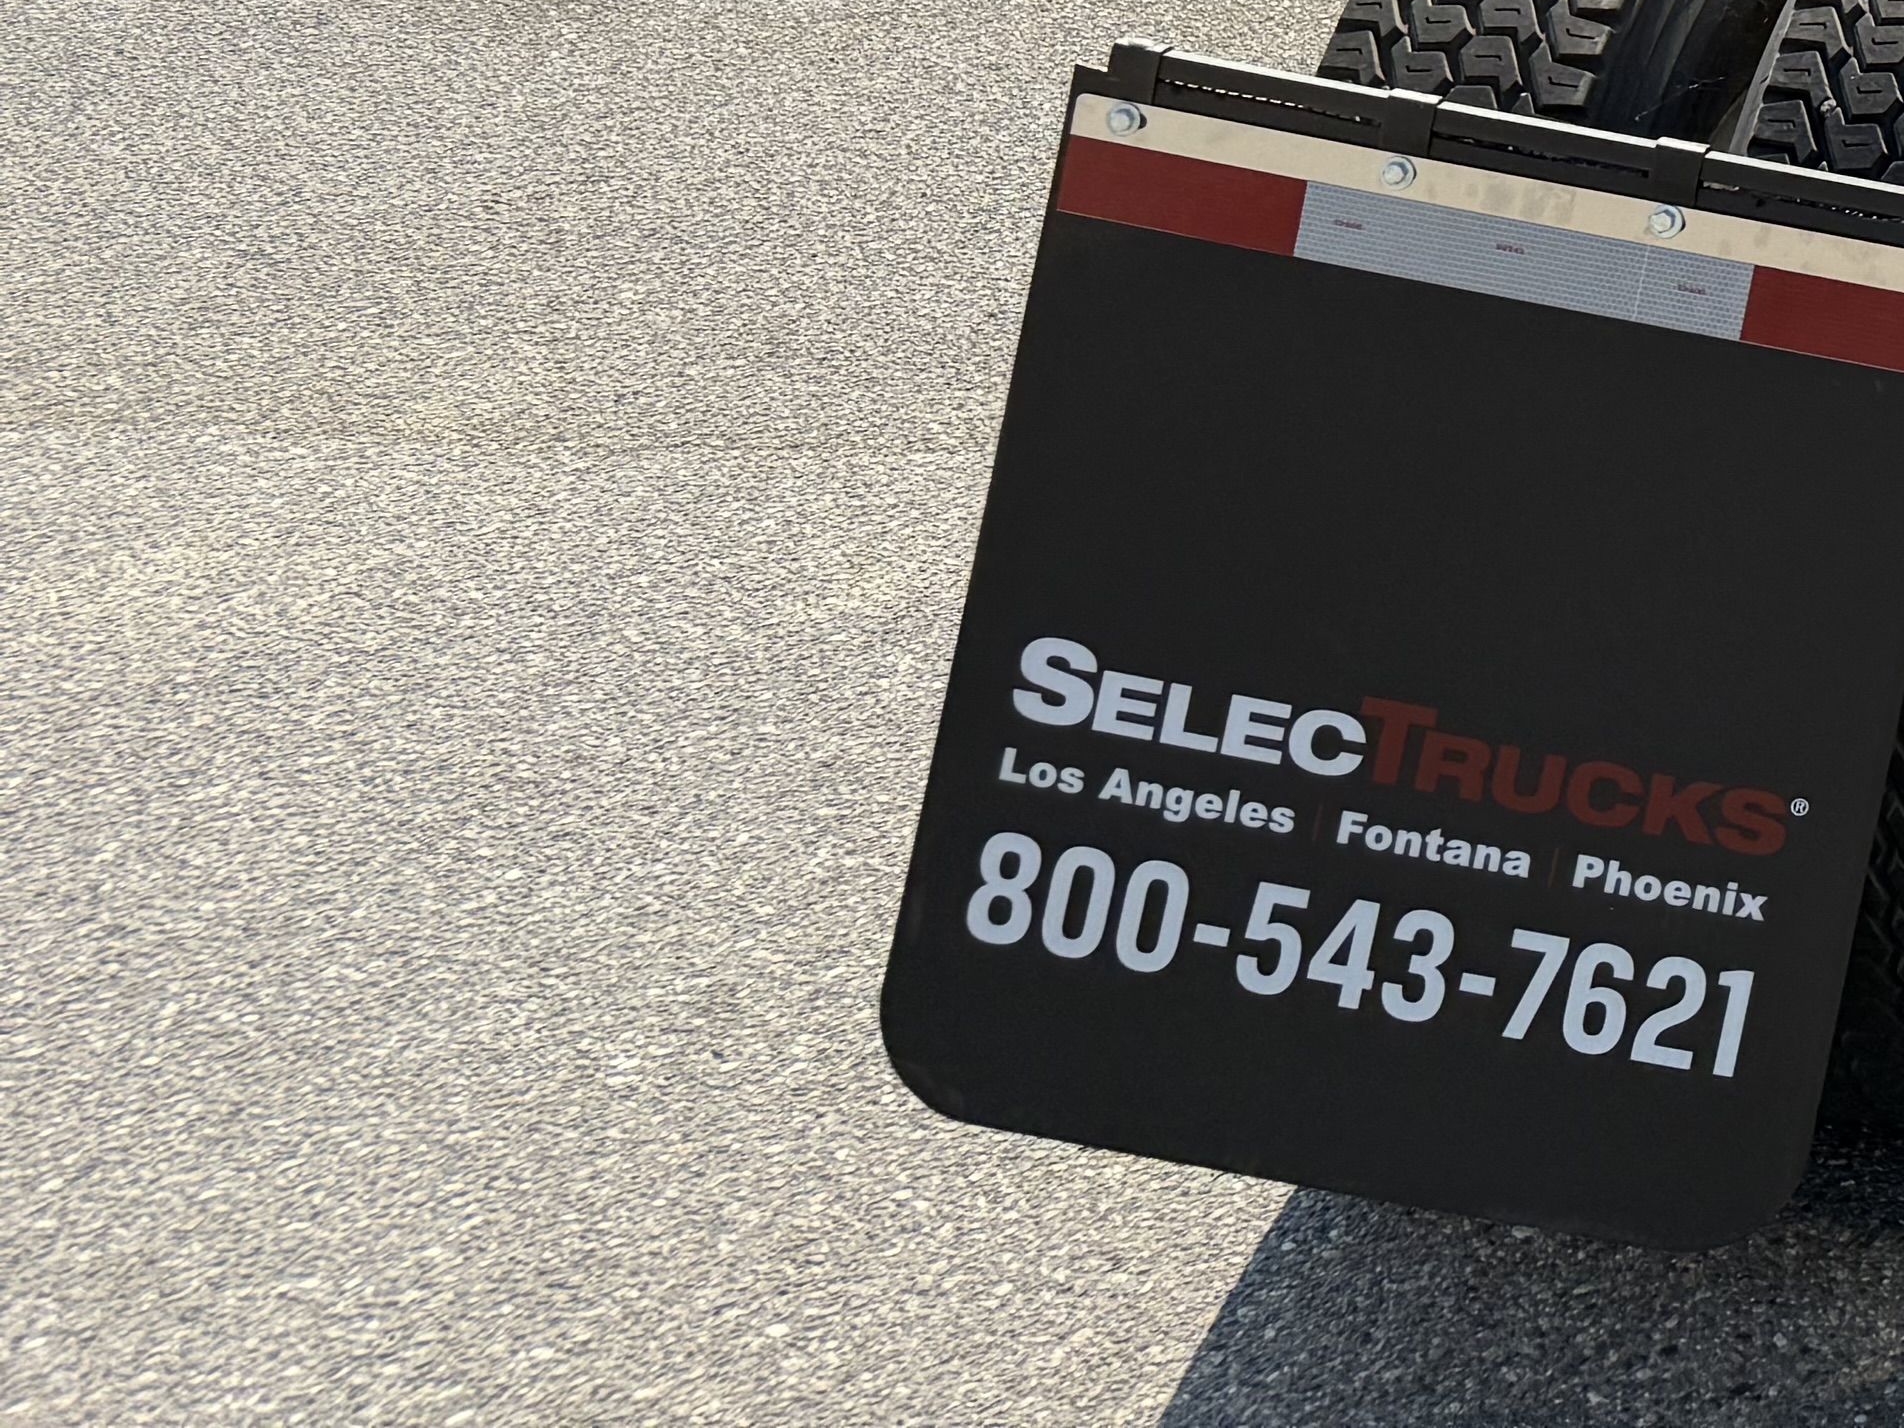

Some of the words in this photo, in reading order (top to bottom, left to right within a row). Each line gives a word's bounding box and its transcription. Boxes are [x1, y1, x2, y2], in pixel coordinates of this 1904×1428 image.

[999, 747, 1084, 793] Los
[1099, 767, 1296, 834] Angeles
[1337, 811, 1531, 879] Fontana
[1573, 855, 1768, 922] Phoenix
[967, 832, 1755, 1078] 800-543-7621
